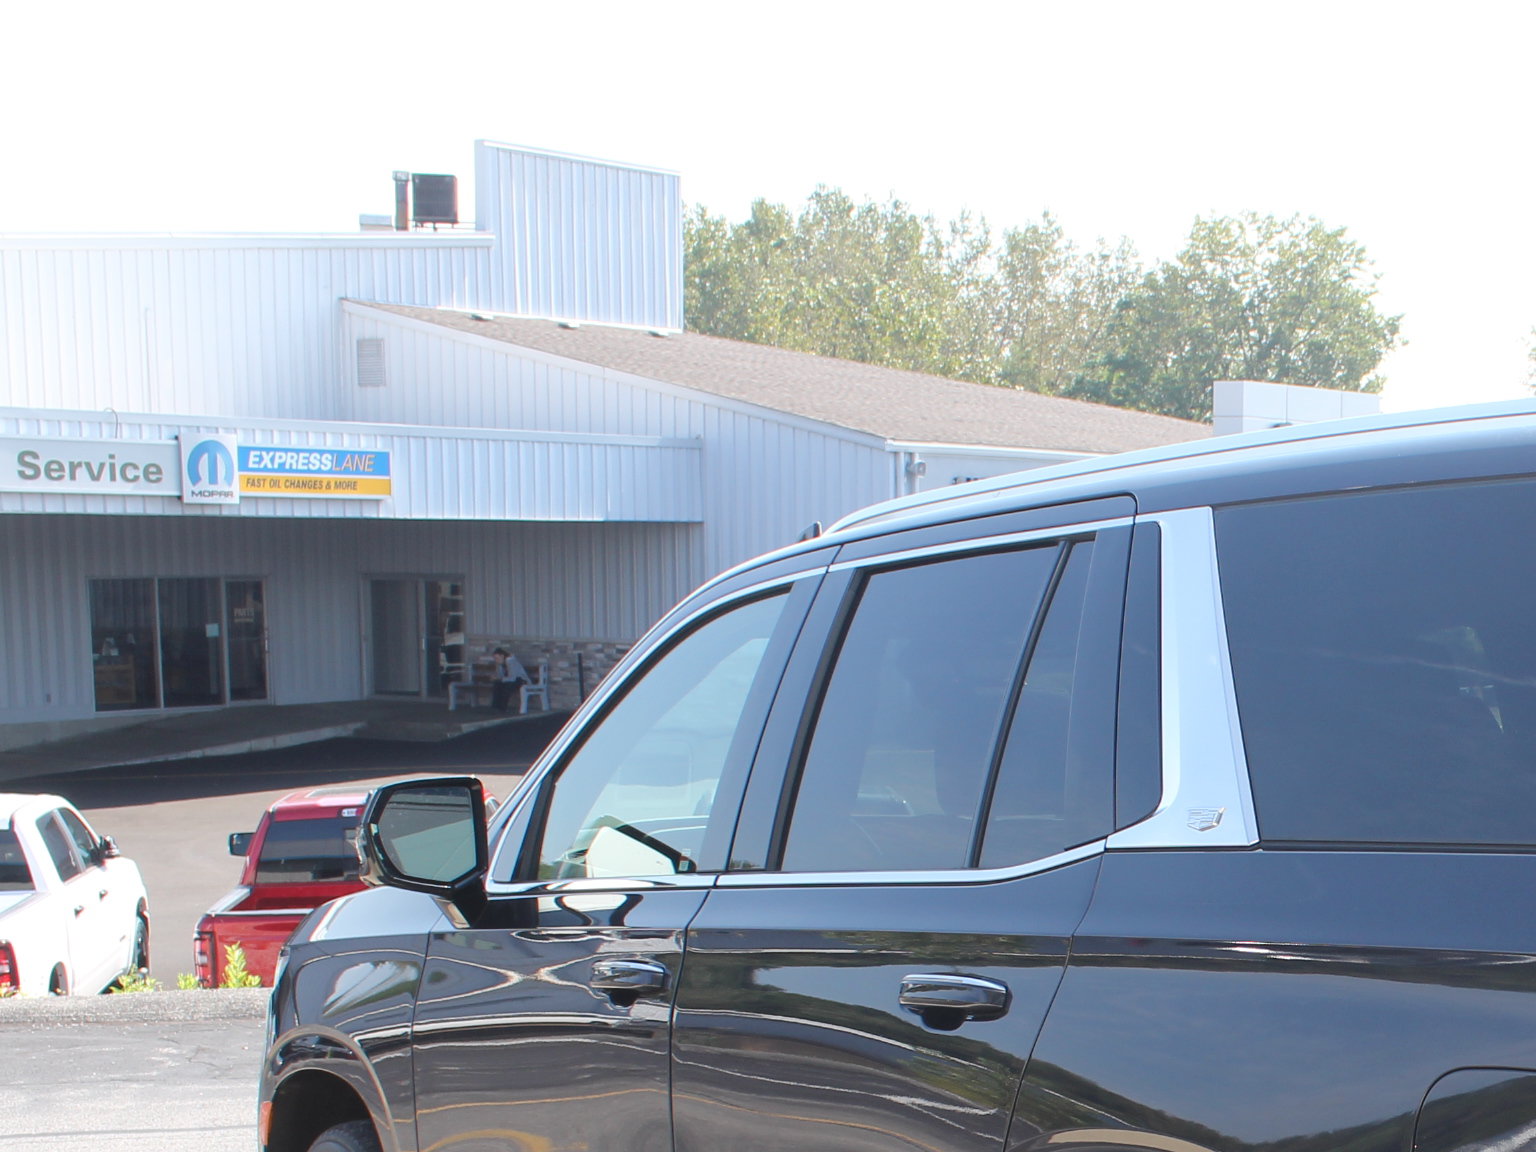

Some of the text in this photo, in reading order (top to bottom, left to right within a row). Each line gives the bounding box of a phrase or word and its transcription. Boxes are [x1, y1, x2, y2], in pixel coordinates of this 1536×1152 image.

[17, 450, 163, 483] Service
[246, 478, 358, 491] FAST OIL CHANGES & MORE
[191, 489, 234, 499] MOPAR
